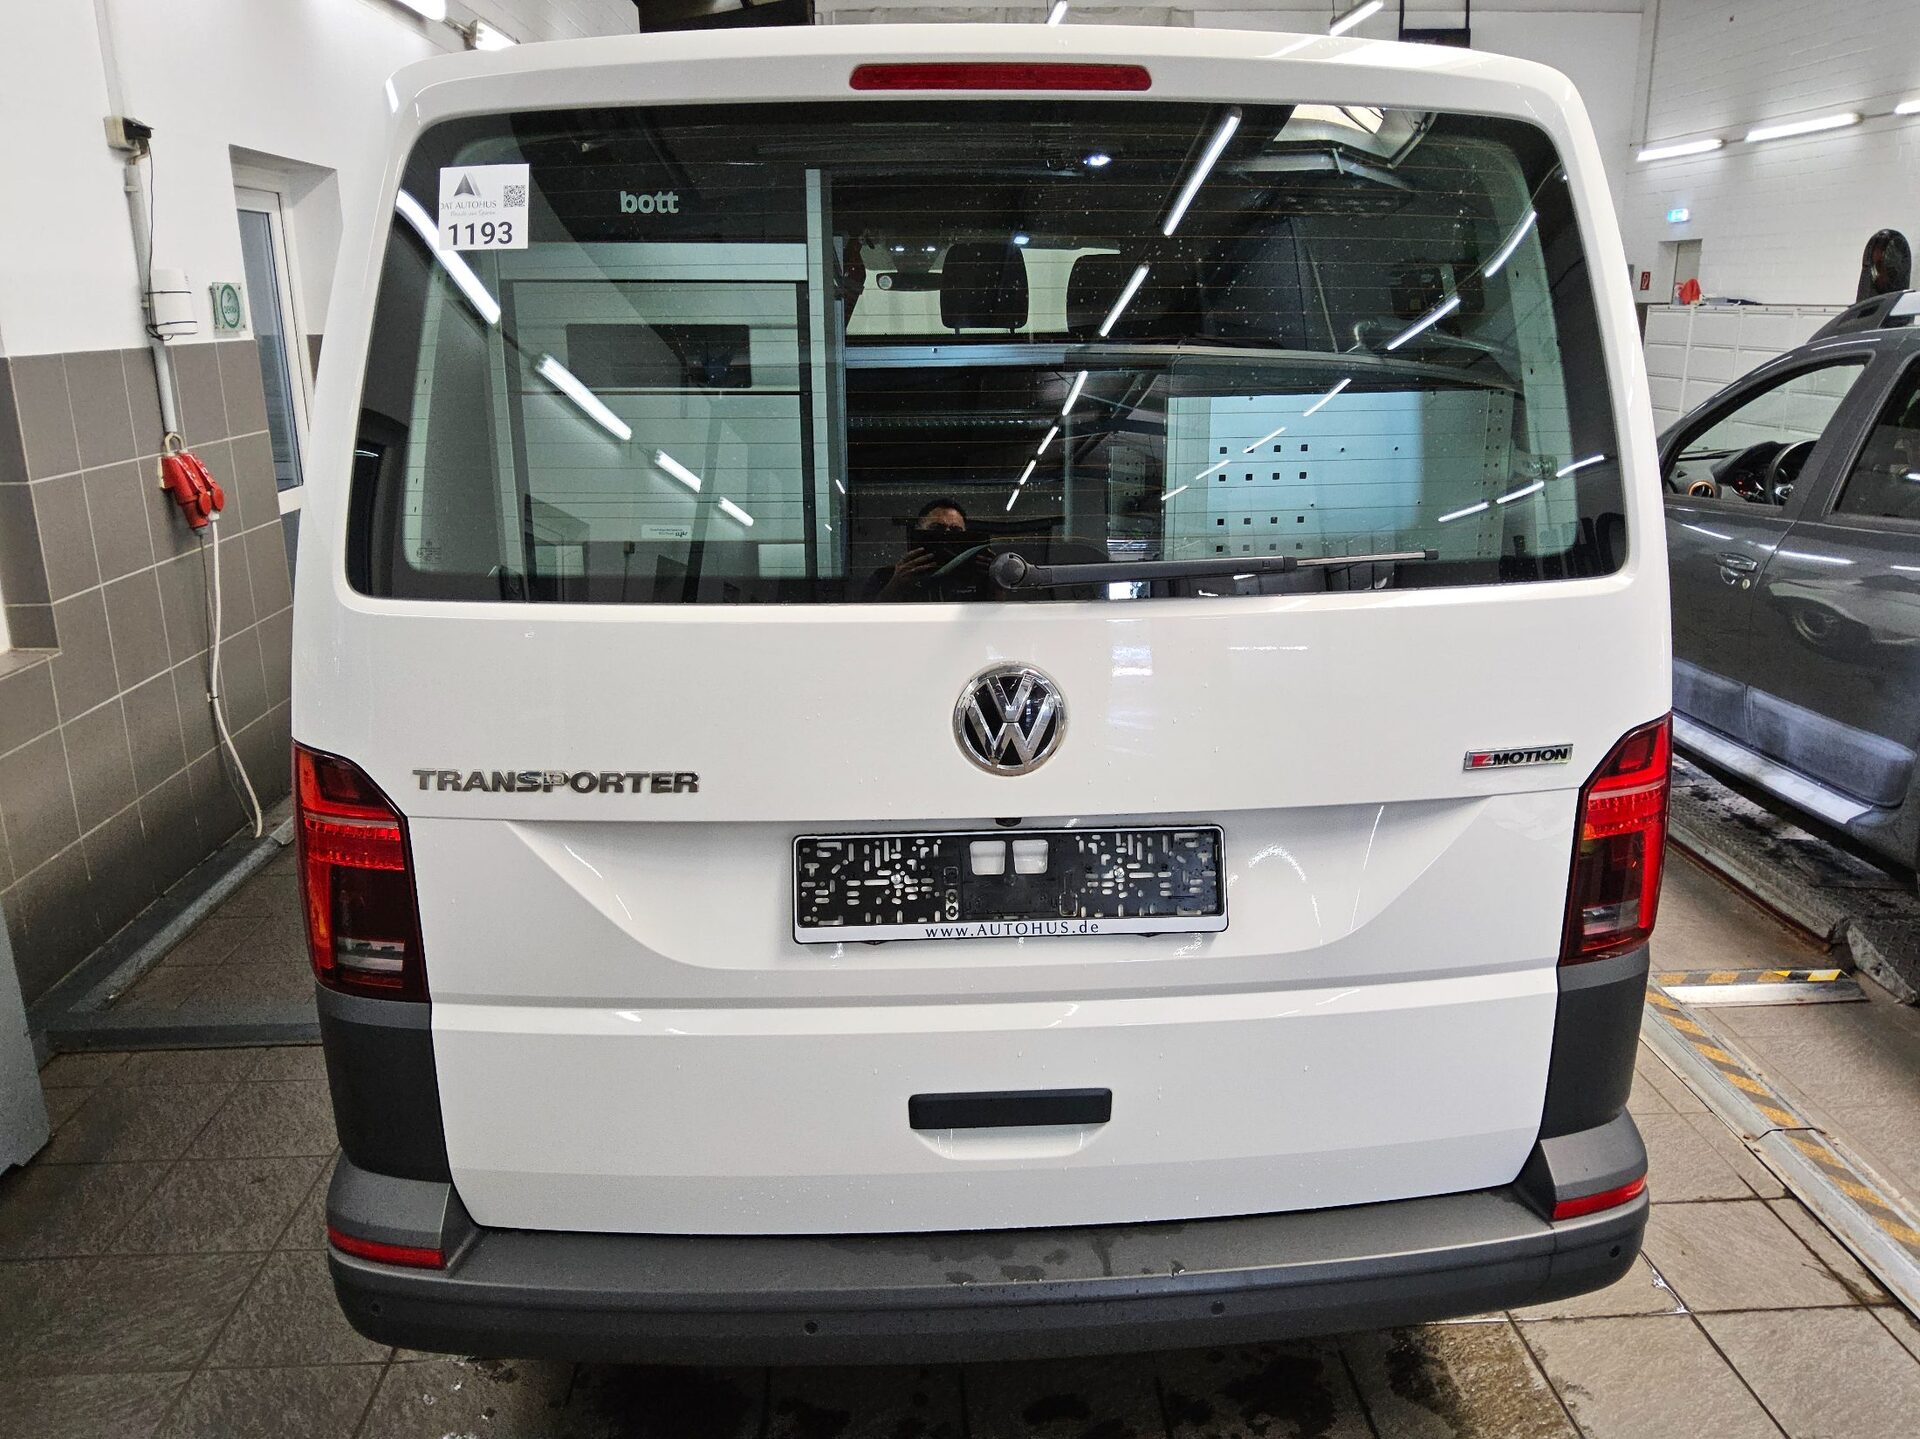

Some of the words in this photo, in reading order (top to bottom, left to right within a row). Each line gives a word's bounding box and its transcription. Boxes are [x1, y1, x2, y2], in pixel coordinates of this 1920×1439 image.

[456, 200, 497, 209] AUTOHUS
[619, 191, 679, 214] bott
[448, 222, 513, 245] 1193
[412, 769, 700, 793] TRANSPORTER
[925, 921, 1099, 937] www.AUTOHUS.de
